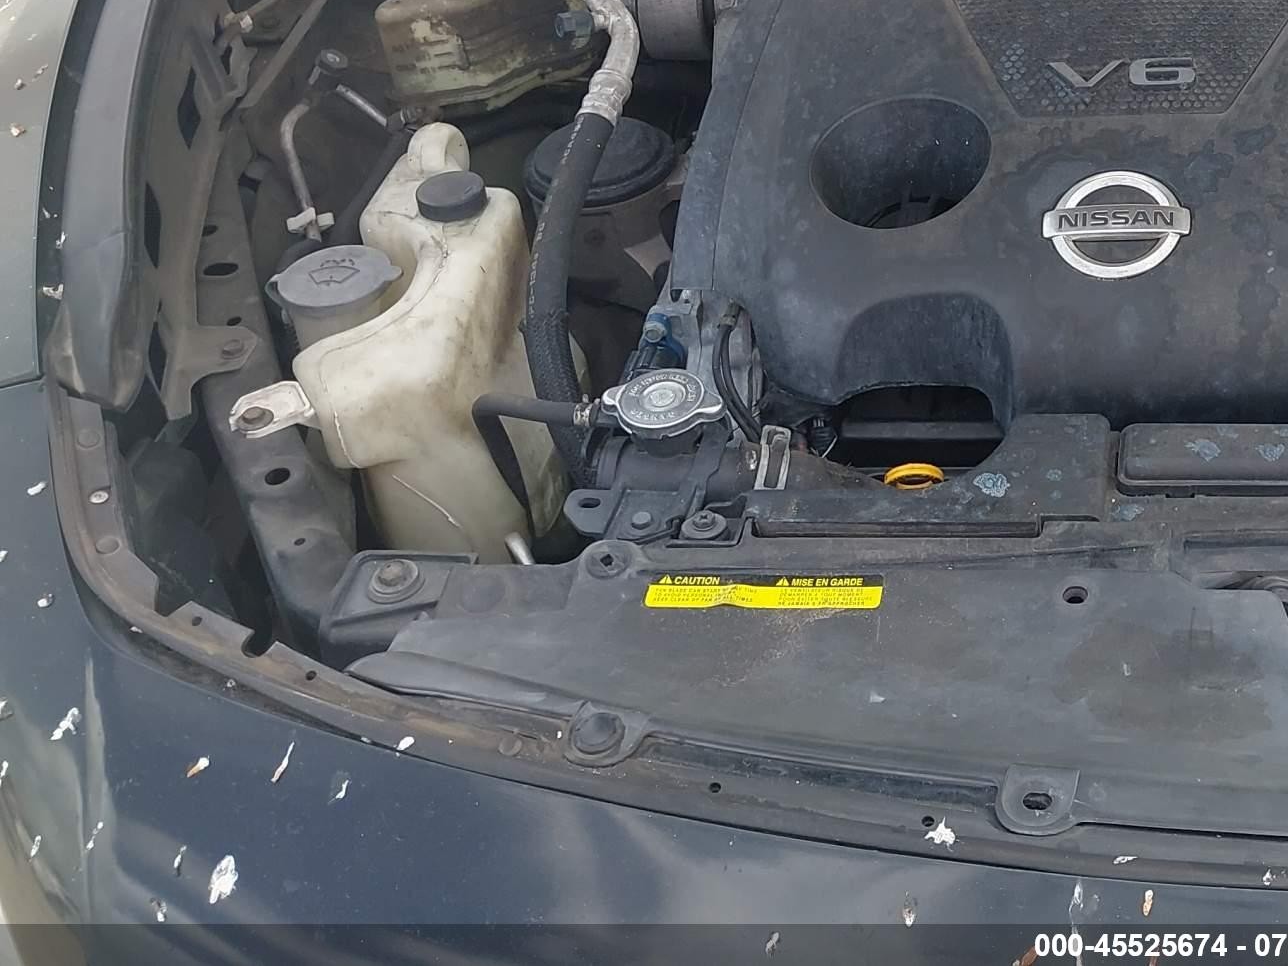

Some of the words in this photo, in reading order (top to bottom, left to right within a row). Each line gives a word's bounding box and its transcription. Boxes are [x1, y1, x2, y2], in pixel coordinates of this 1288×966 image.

[1048, 58, 1196, 88] V6
[1058, 211, 1174, 230] NISSAN
[674, 576, 720, 585] CAUTION
[791, 578, 814, 586] MISE
[815, 578, 829, 586] EN
[830, 577, 864, 586] GARDE
